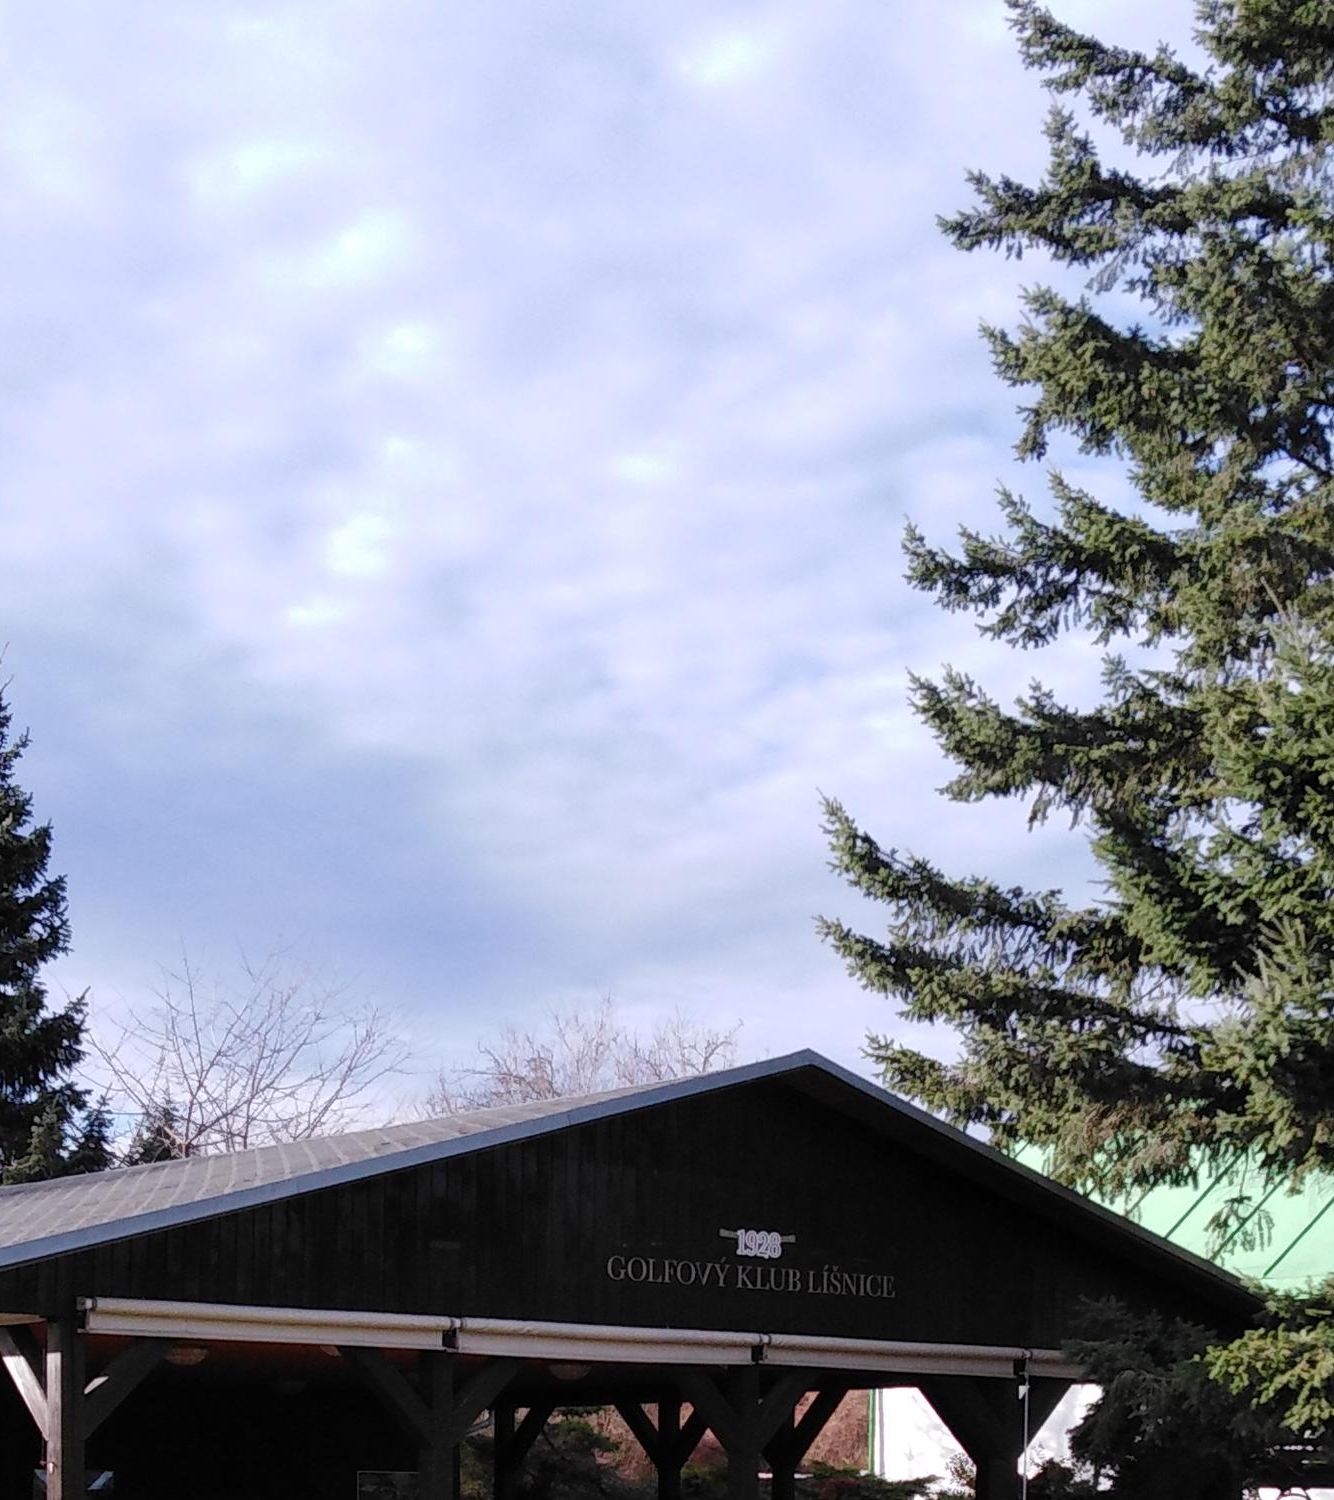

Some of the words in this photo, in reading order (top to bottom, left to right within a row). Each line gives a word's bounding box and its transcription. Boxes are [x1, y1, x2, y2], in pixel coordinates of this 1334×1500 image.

[736, 1228, 782, 1258] 1928
[607, 1255, 729, 1287] GOLFOVÝ
[736, 1265, 801, 1292] KLUB
[808, 1264, 896, 1298] LÍŠNICE
